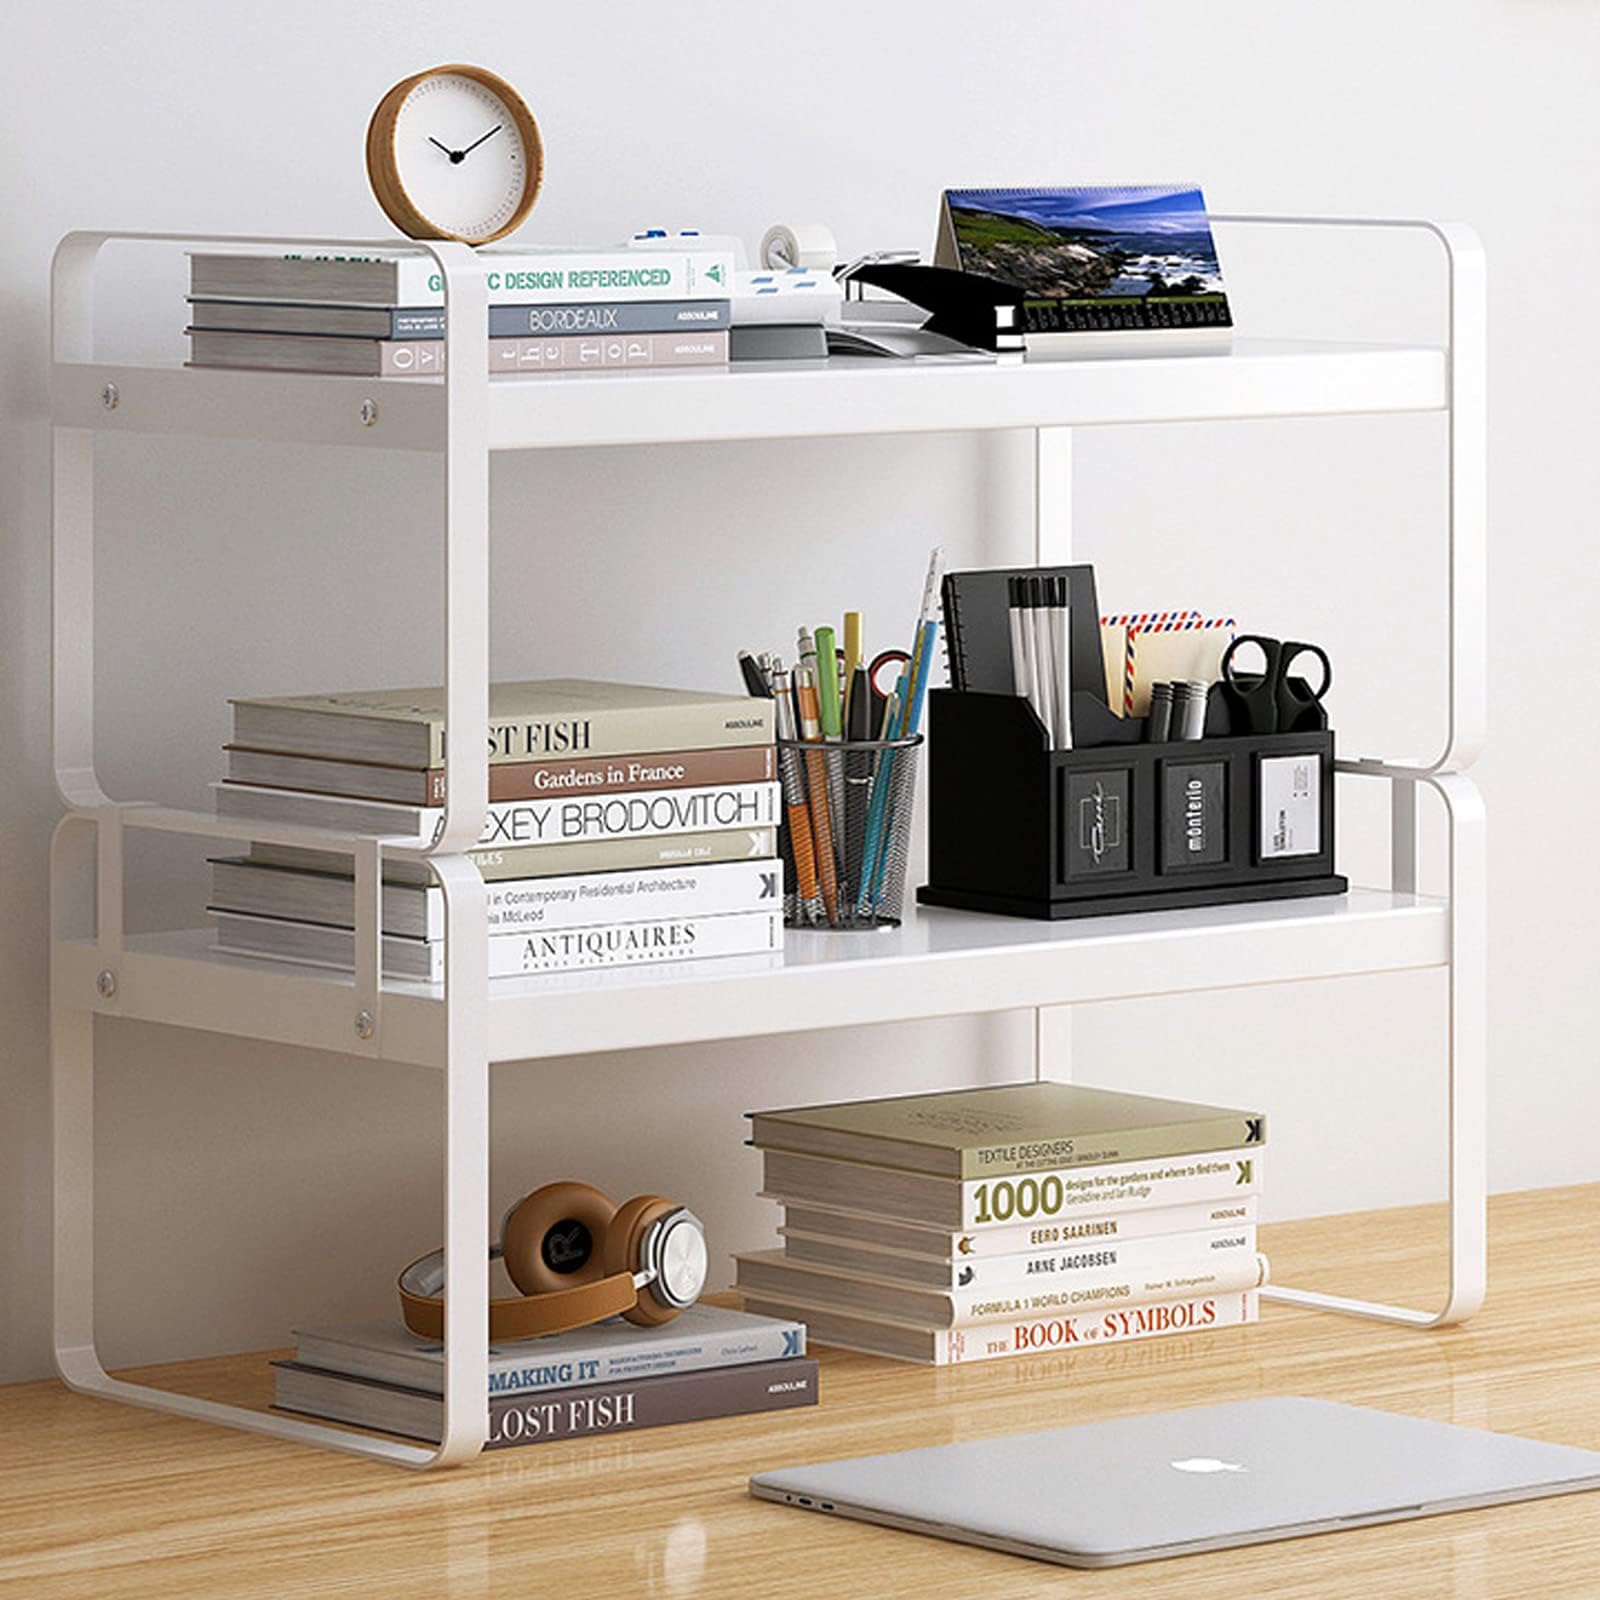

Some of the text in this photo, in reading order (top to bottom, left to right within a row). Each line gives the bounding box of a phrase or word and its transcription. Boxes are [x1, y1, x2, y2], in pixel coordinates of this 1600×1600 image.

[505, 271, 564, 290] DESIGN
[568, 268, 671, 289] REFERENCED
[529, 309, 619, 331] BORDEAUX
[526, 721, 590, 753] FISH
[534, 763, 684, 790] Gardens in France
[562, 790, 759, 837] BRODOVITCH
[523, 923, 695, 959] ANTIQUAIRES
[1018, 1140, 1073, 1160] DESIGNERS
[974, 1175, 1063, 1224] 1000
[1030, 1221, 1117, 1245] EERO SAARINEN
[1027, 1251, 1117, 1275] ARNE JACOBSEN
[1014, 1318, 1078, 1350] BOOK
[1103, 1300, 1216, 1338] SYMBOLS
[489, 1360, 600, 1392] MAKING IT
[488, 1393, 636, 1442] LOST FISH
